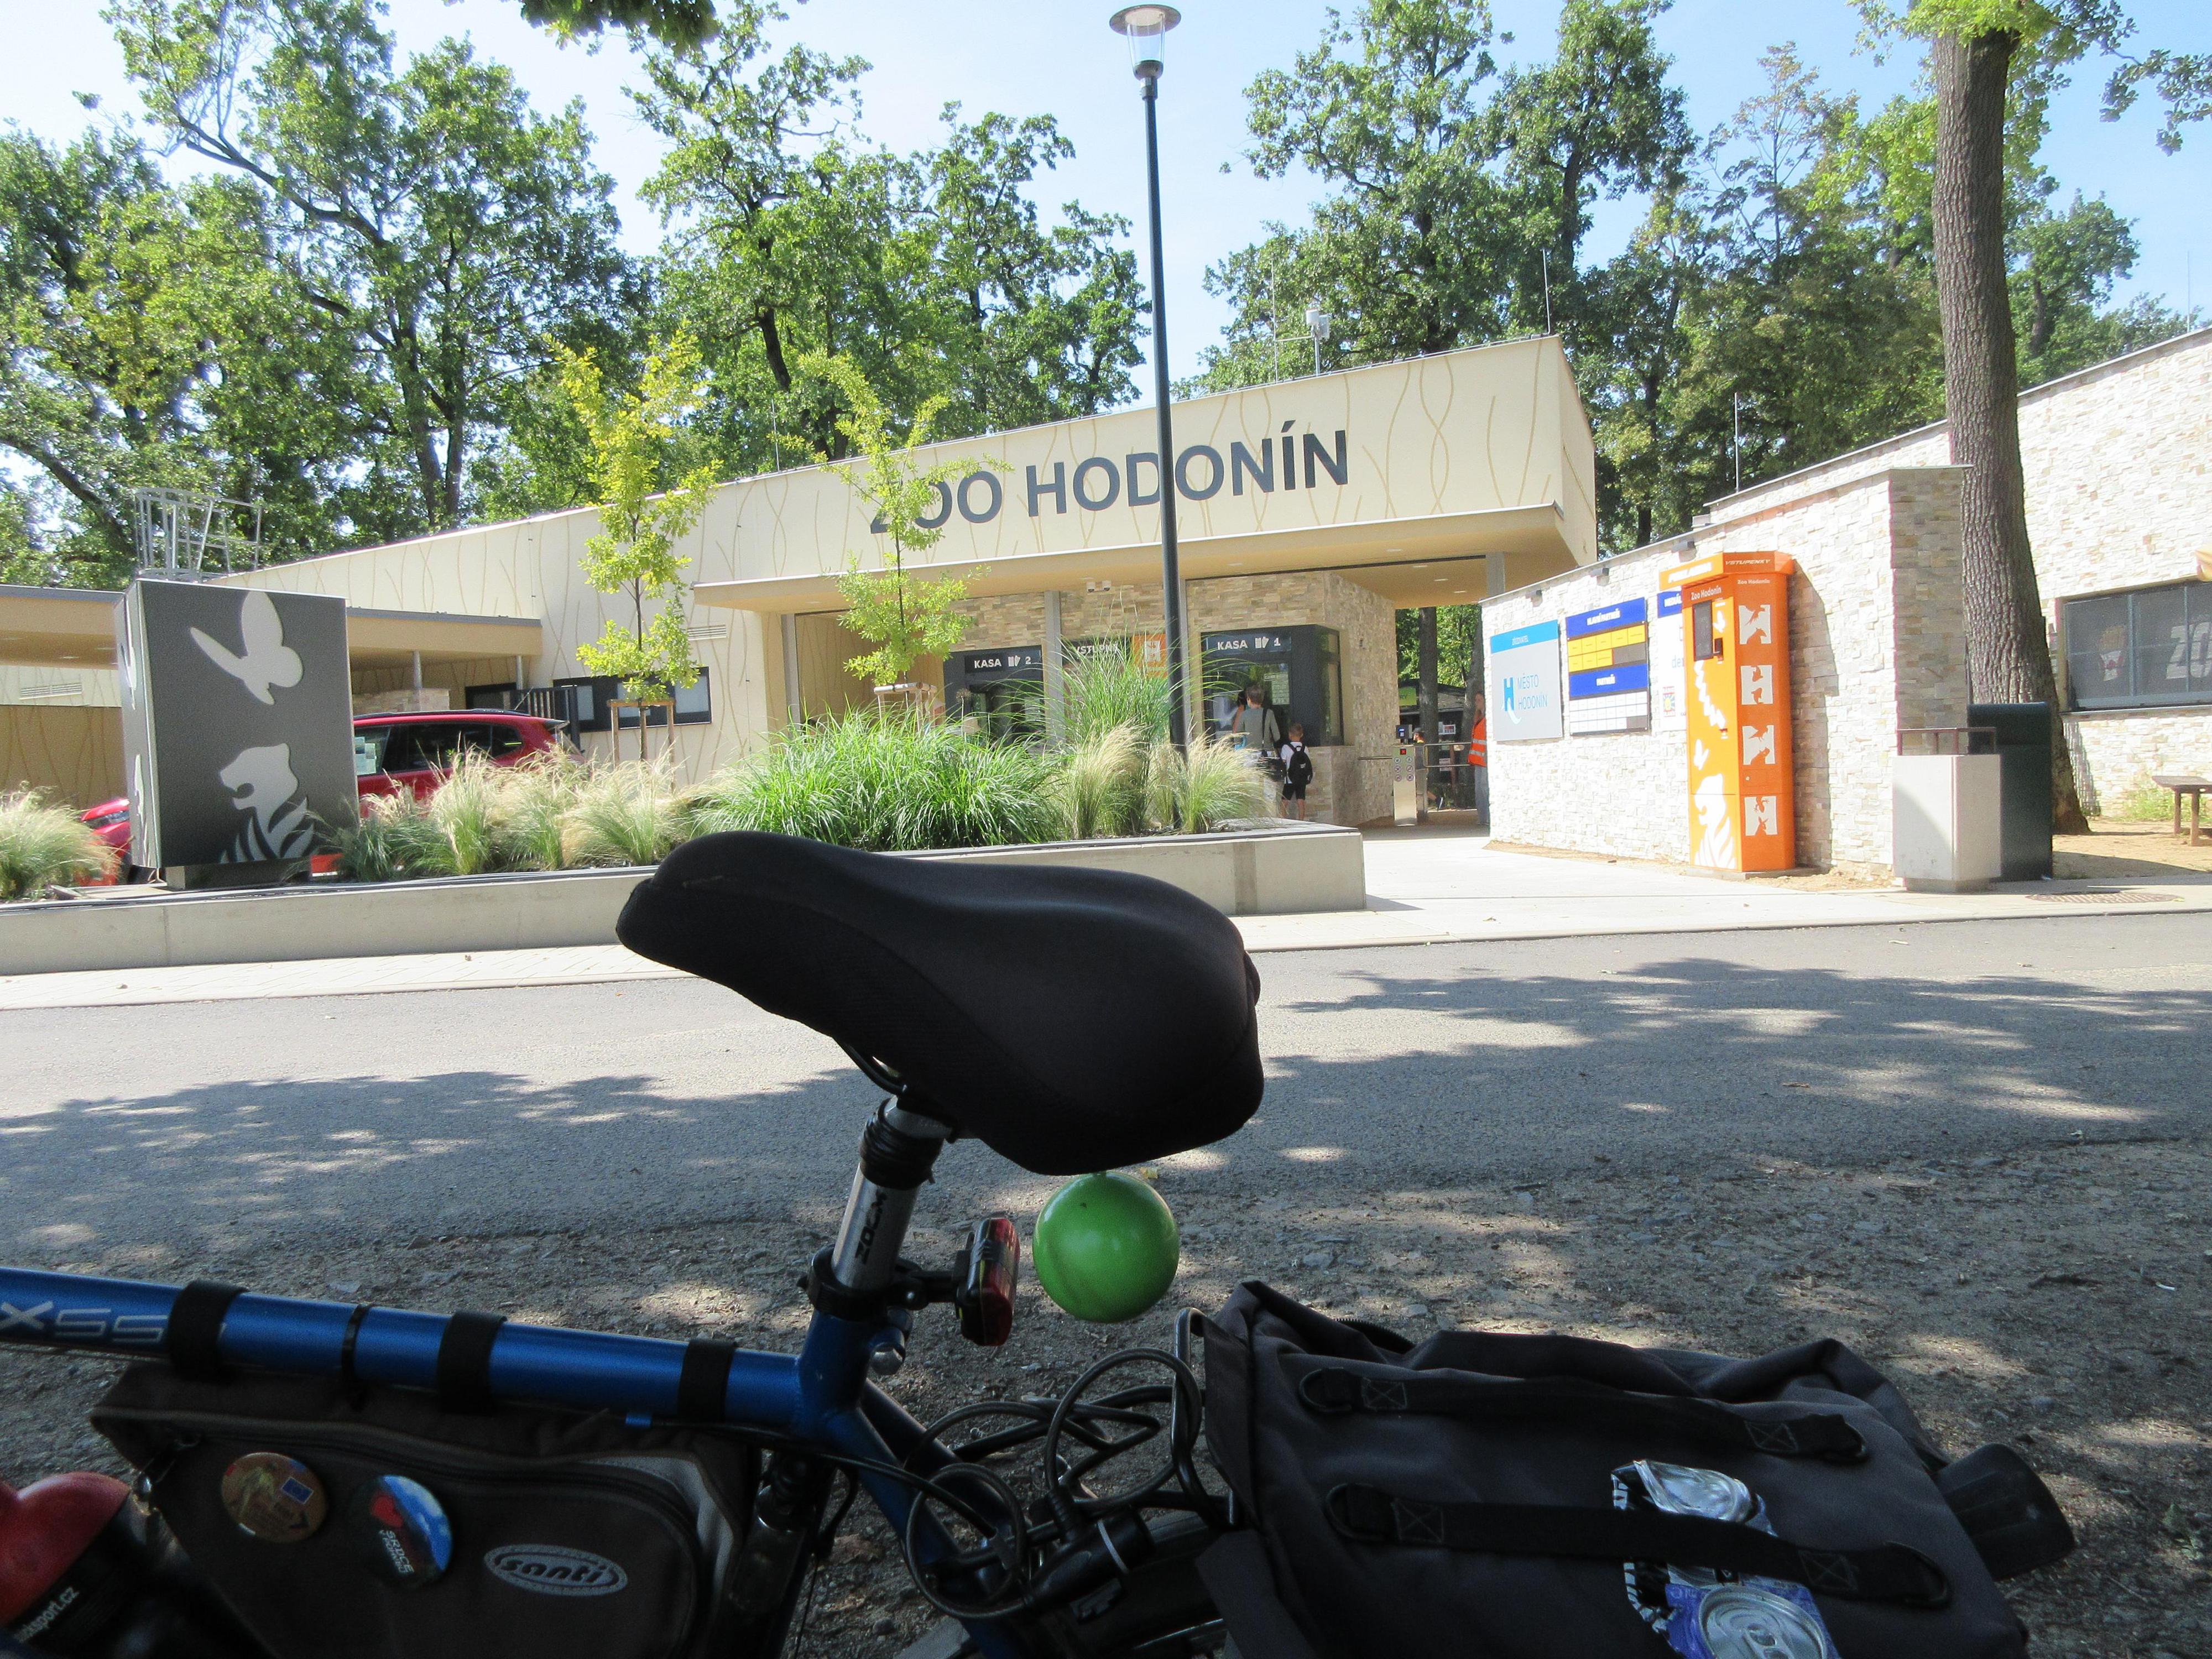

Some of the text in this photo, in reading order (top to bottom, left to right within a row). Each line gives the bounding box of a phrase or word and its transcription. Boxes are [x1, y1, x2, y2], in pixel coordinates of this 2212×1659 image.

[1026, 420, 1348, 518] HODONÍN
[1691, 585, 1721, 601] Zoo Hodonín
[1217, 637, 1281, 650] KASA 1
[974, 656, 1031, 669] KASA 2
[1518, 692, 1548, 710] HODONÍN
[385, 1530, 415, 1573] SRDCE
